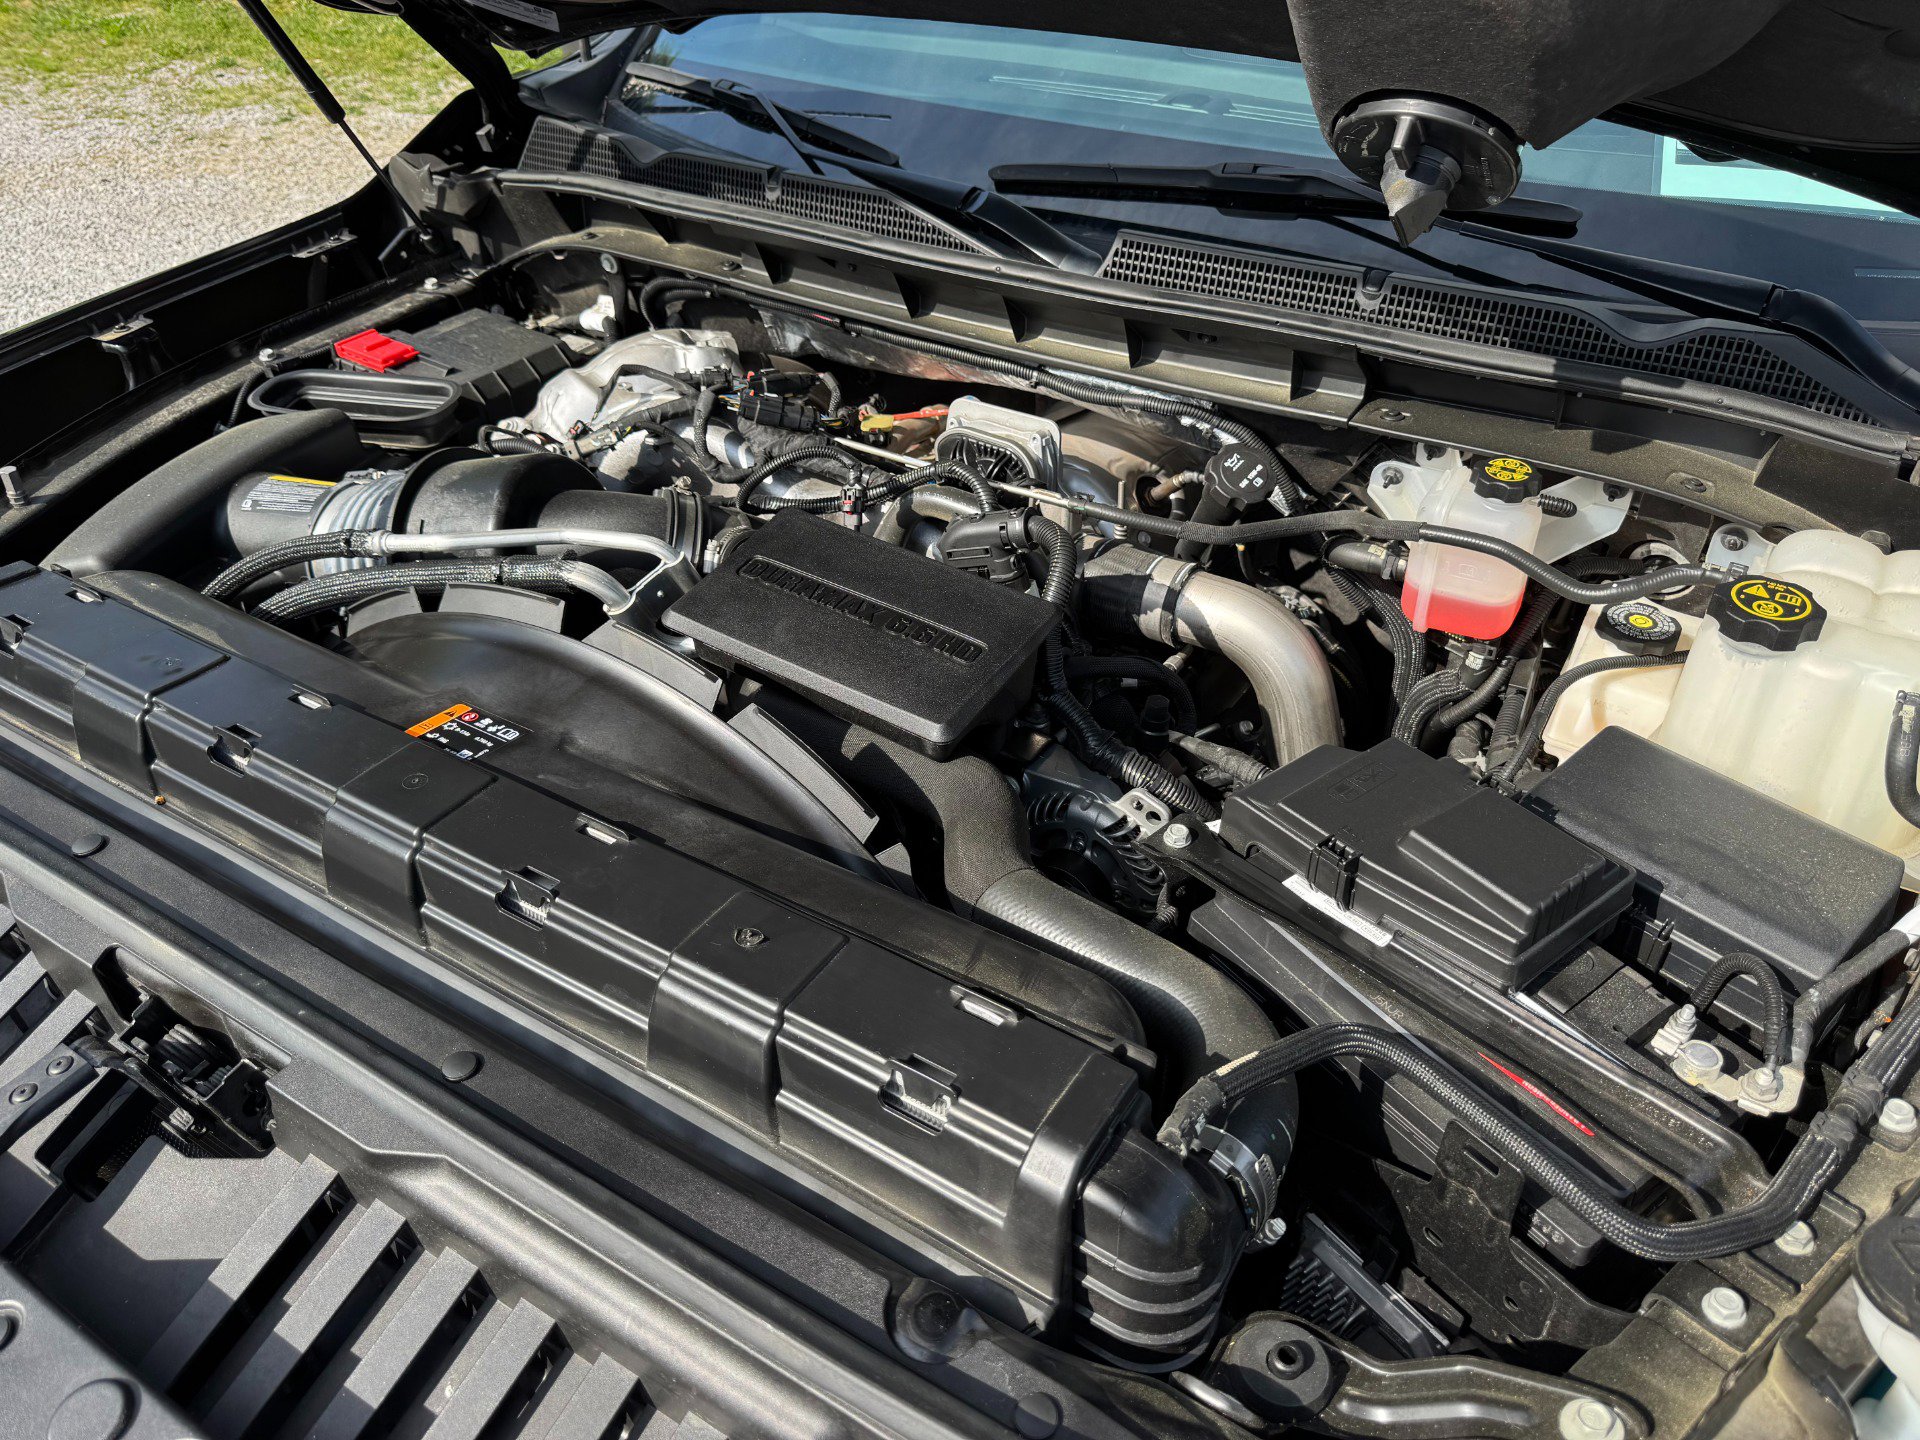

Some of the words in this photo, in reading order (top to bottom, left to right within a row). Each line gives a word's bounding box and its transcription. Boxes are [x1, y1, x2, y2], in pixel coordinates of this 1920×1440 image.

[743, 558, 886, 625] DURAMAX
[885, 617, 935, 646] 6.6
[933, 634, 984, 664] HD
